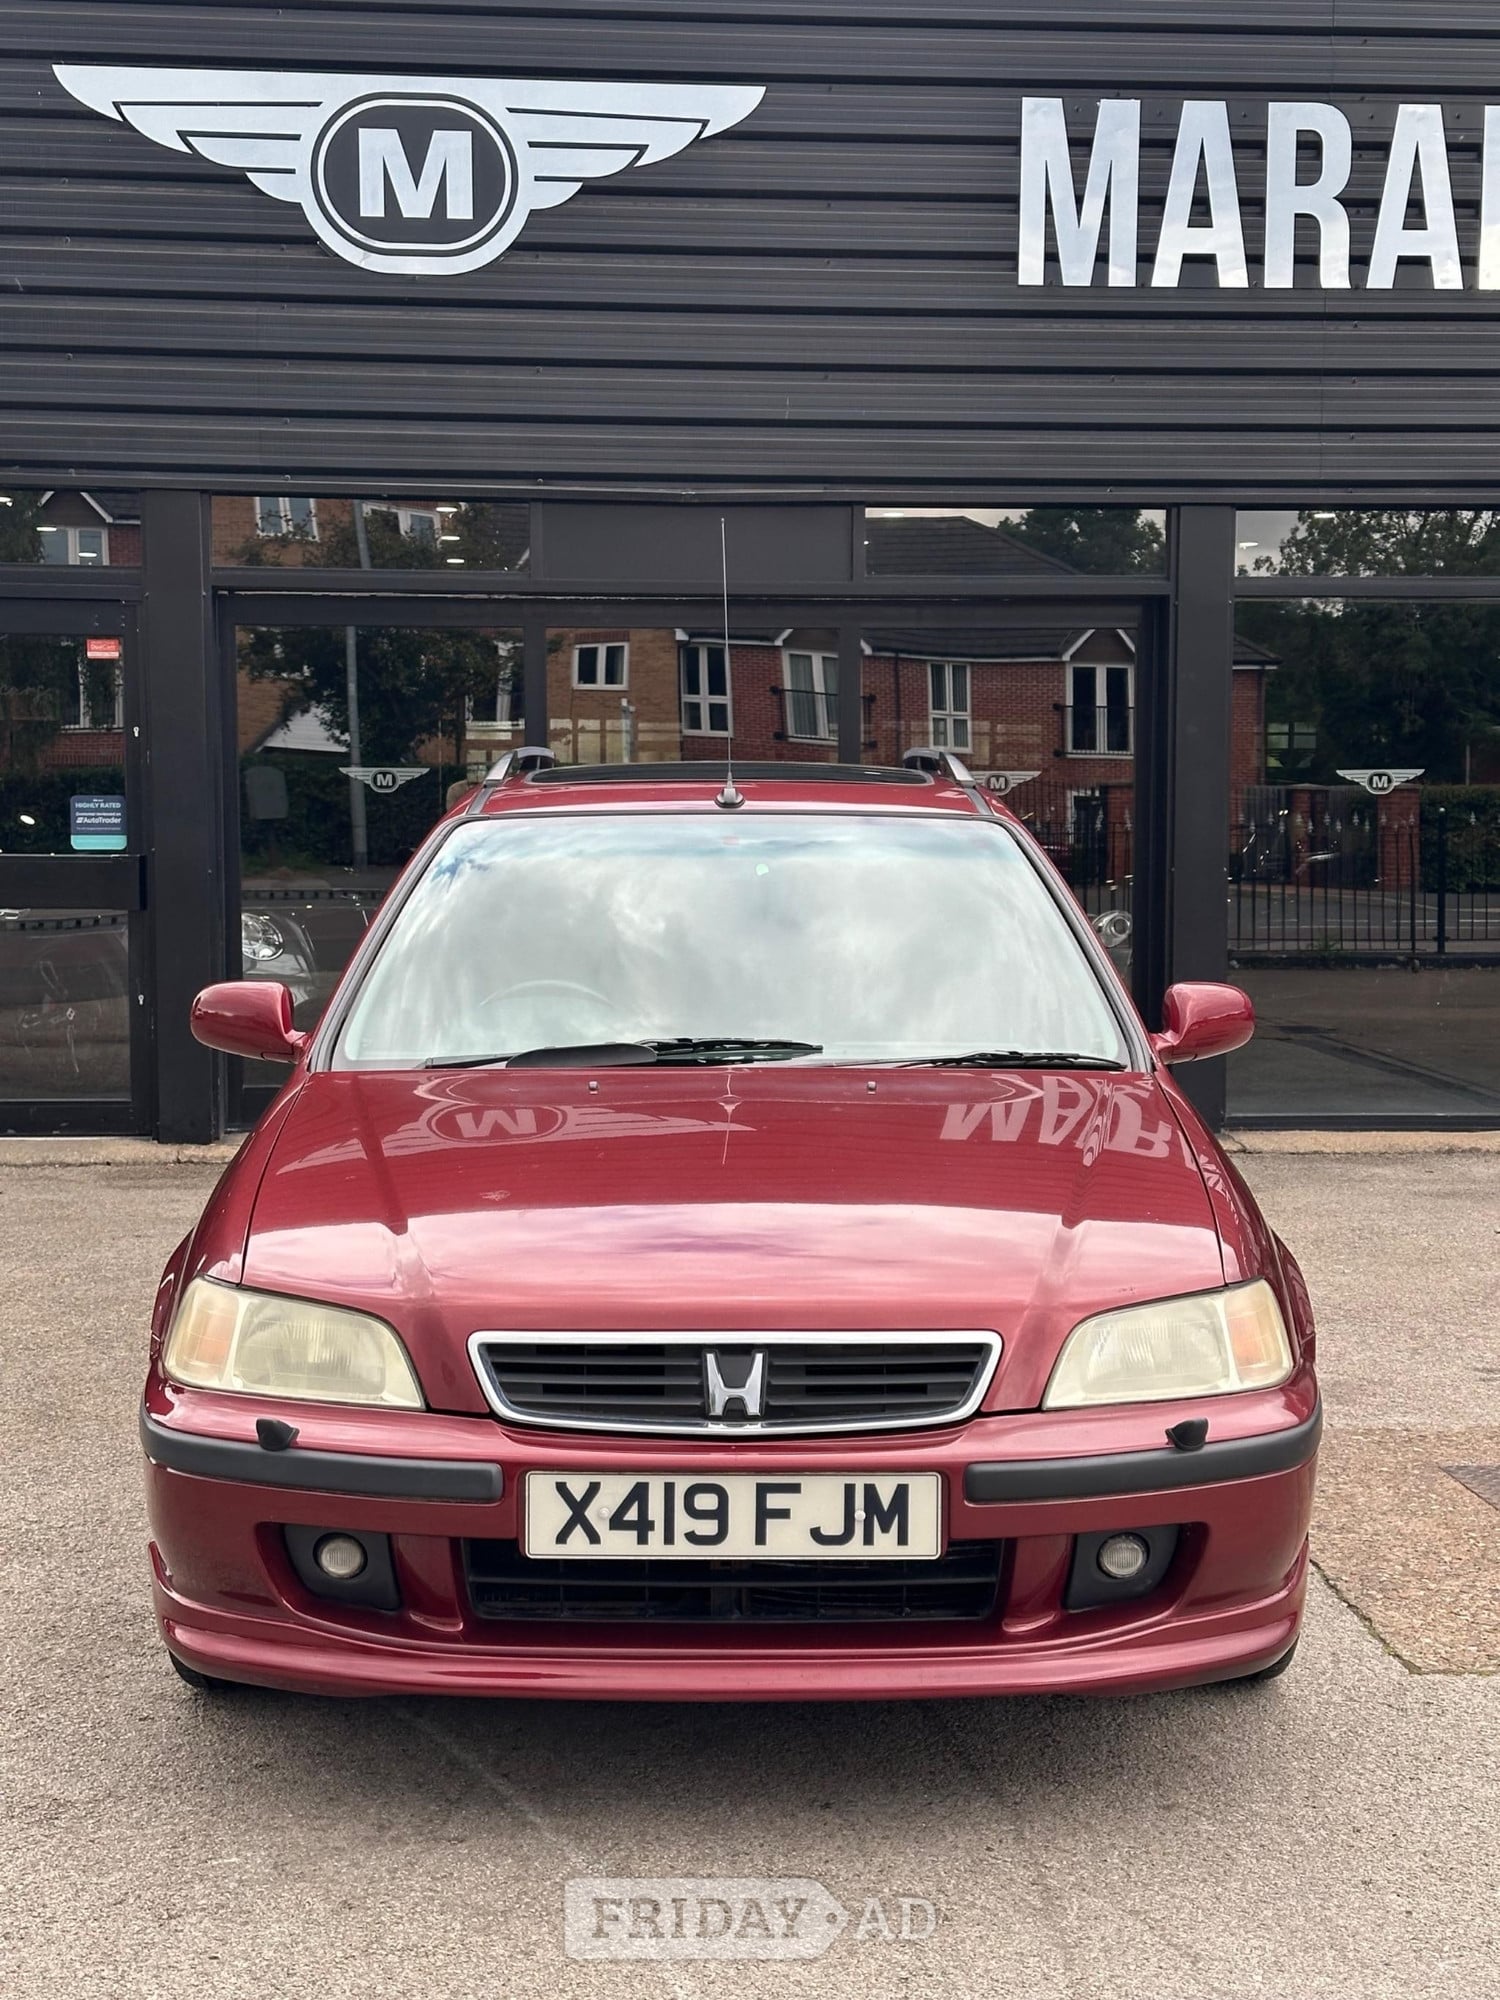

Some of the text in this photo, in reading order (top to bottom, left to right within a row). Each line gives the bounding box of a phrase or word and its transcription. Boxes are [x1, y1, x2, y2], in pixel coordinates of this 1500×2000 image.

[357, 127, 474, 220] M
[376, 773, 393, 787] M
[989, 776, 1006, 790] M
[1372, 775, 1389, 788] M
[554, 1480, 730, 1546] X419
